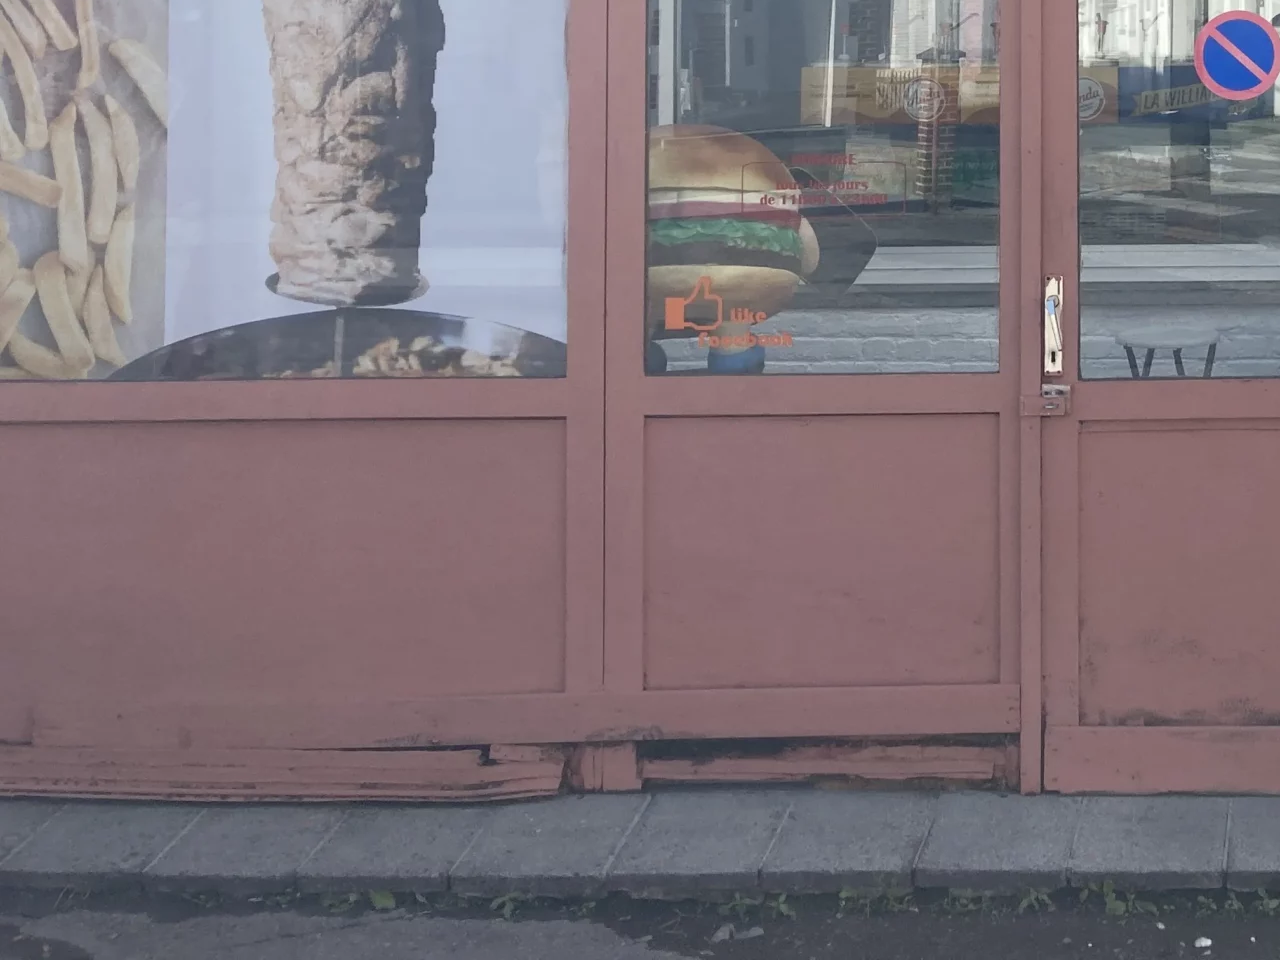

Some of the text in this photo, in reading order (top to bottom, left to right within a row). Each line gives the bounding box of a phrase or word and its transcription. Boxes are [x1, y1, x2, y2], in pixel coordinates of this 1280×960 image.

[1143, 93, 1160, 109] LA
[760, 193, 775, 205] de
[730, 307, 767, 325] like
